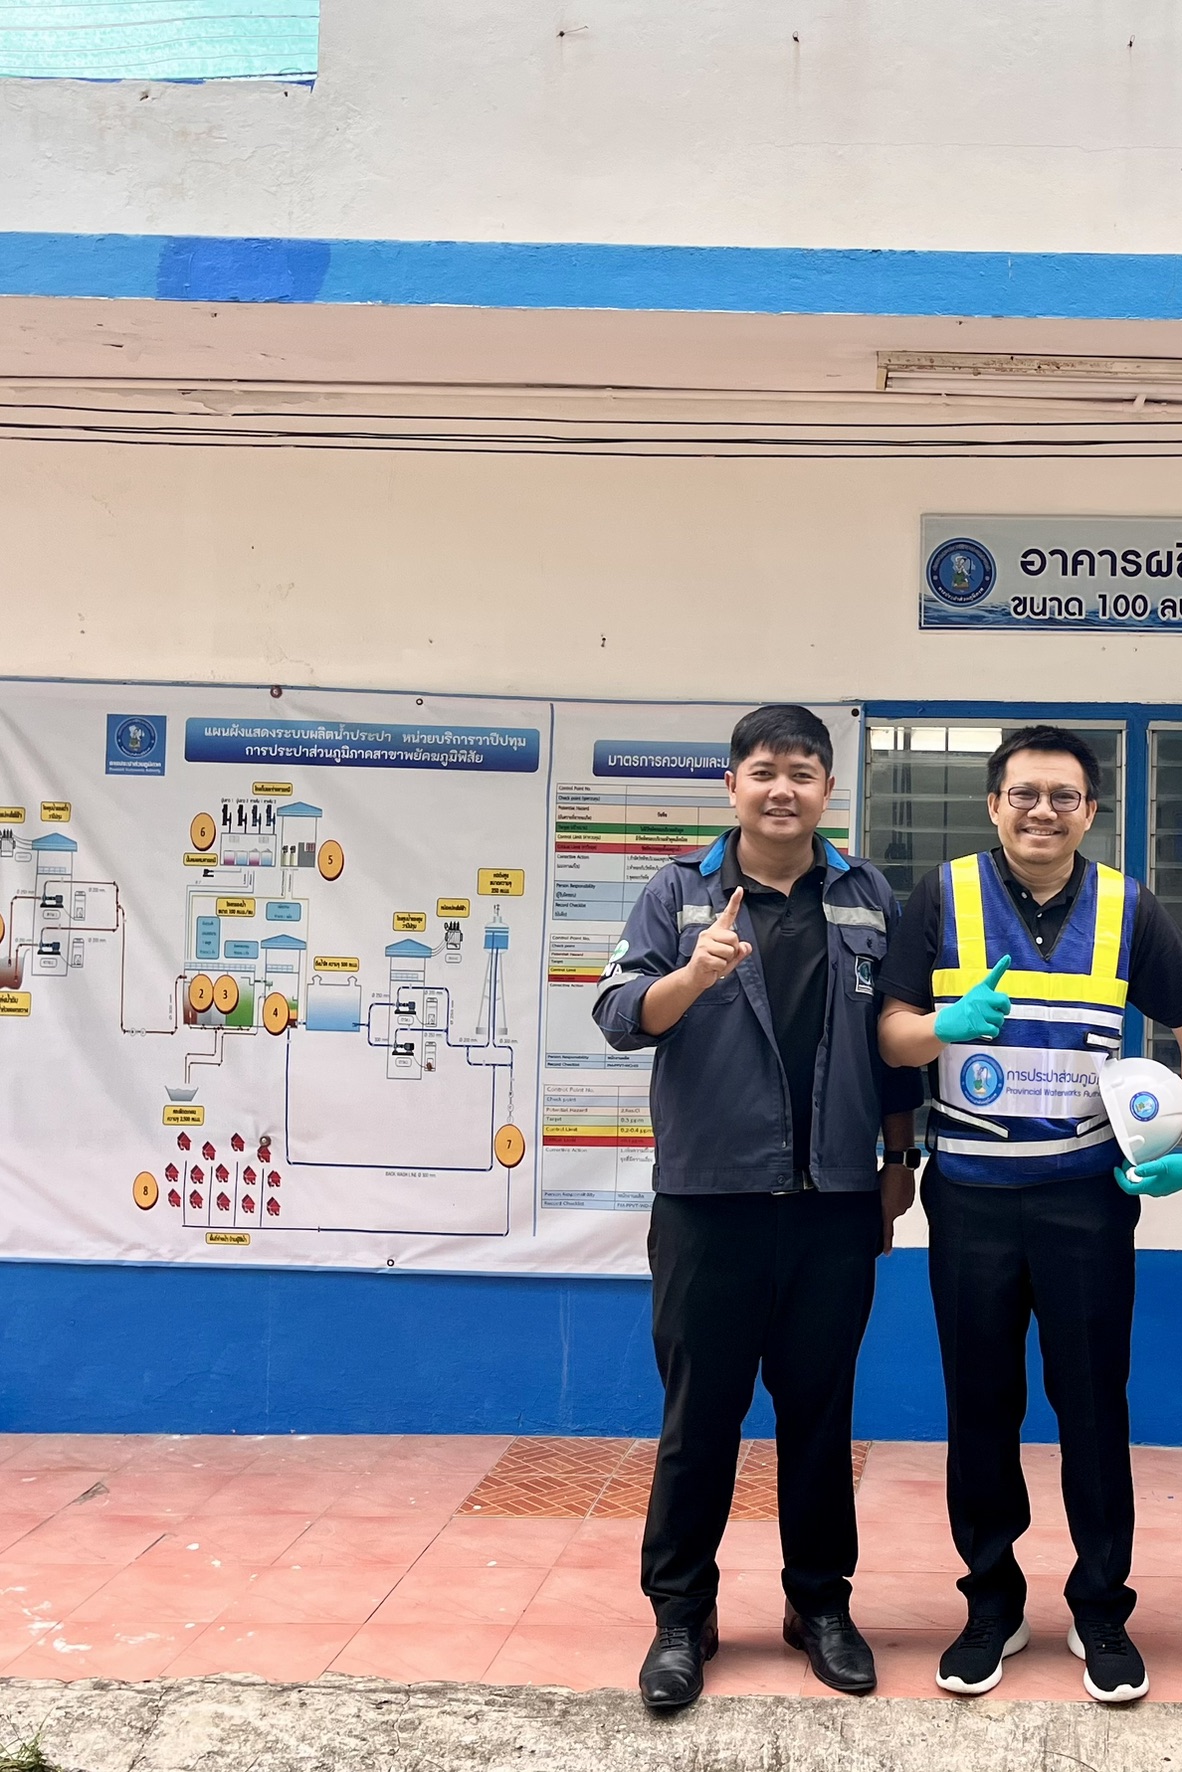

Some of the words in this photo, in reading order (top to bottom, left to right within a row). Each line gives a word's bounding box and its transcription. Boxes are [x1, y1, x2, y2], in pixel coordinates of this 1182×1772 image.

[1011, 593, 1087, 620] ขนาด
[1099, 593, 1149, 619] 100
[204, 723, 392, 743] แผนผังแสดงระบบผลิตน้ำประปา
[402, 732, 526, 751] หน่วยบริการวาปีปทุม
[245, 744, 484, 767] การประปาส่วนภูมิภาคสาขาพยัคฆภูมิพิสัย
[200, 827, 206, 837] 6
[327, 855, 333, 865] 5
[198, 989, 204, 999] 2
[222, 990, 228, 999] 3
[272, 1007, 278, 1017] 4
[1006, 1086, 1042, 1096] Provincial
[1044, 1088, 1081, 1097] Waterworks
[1083, 1090, 1101, 1098] Auth
[506, 1140, 512, 1150] 7
[143, 1186, 149, 1196] 8
